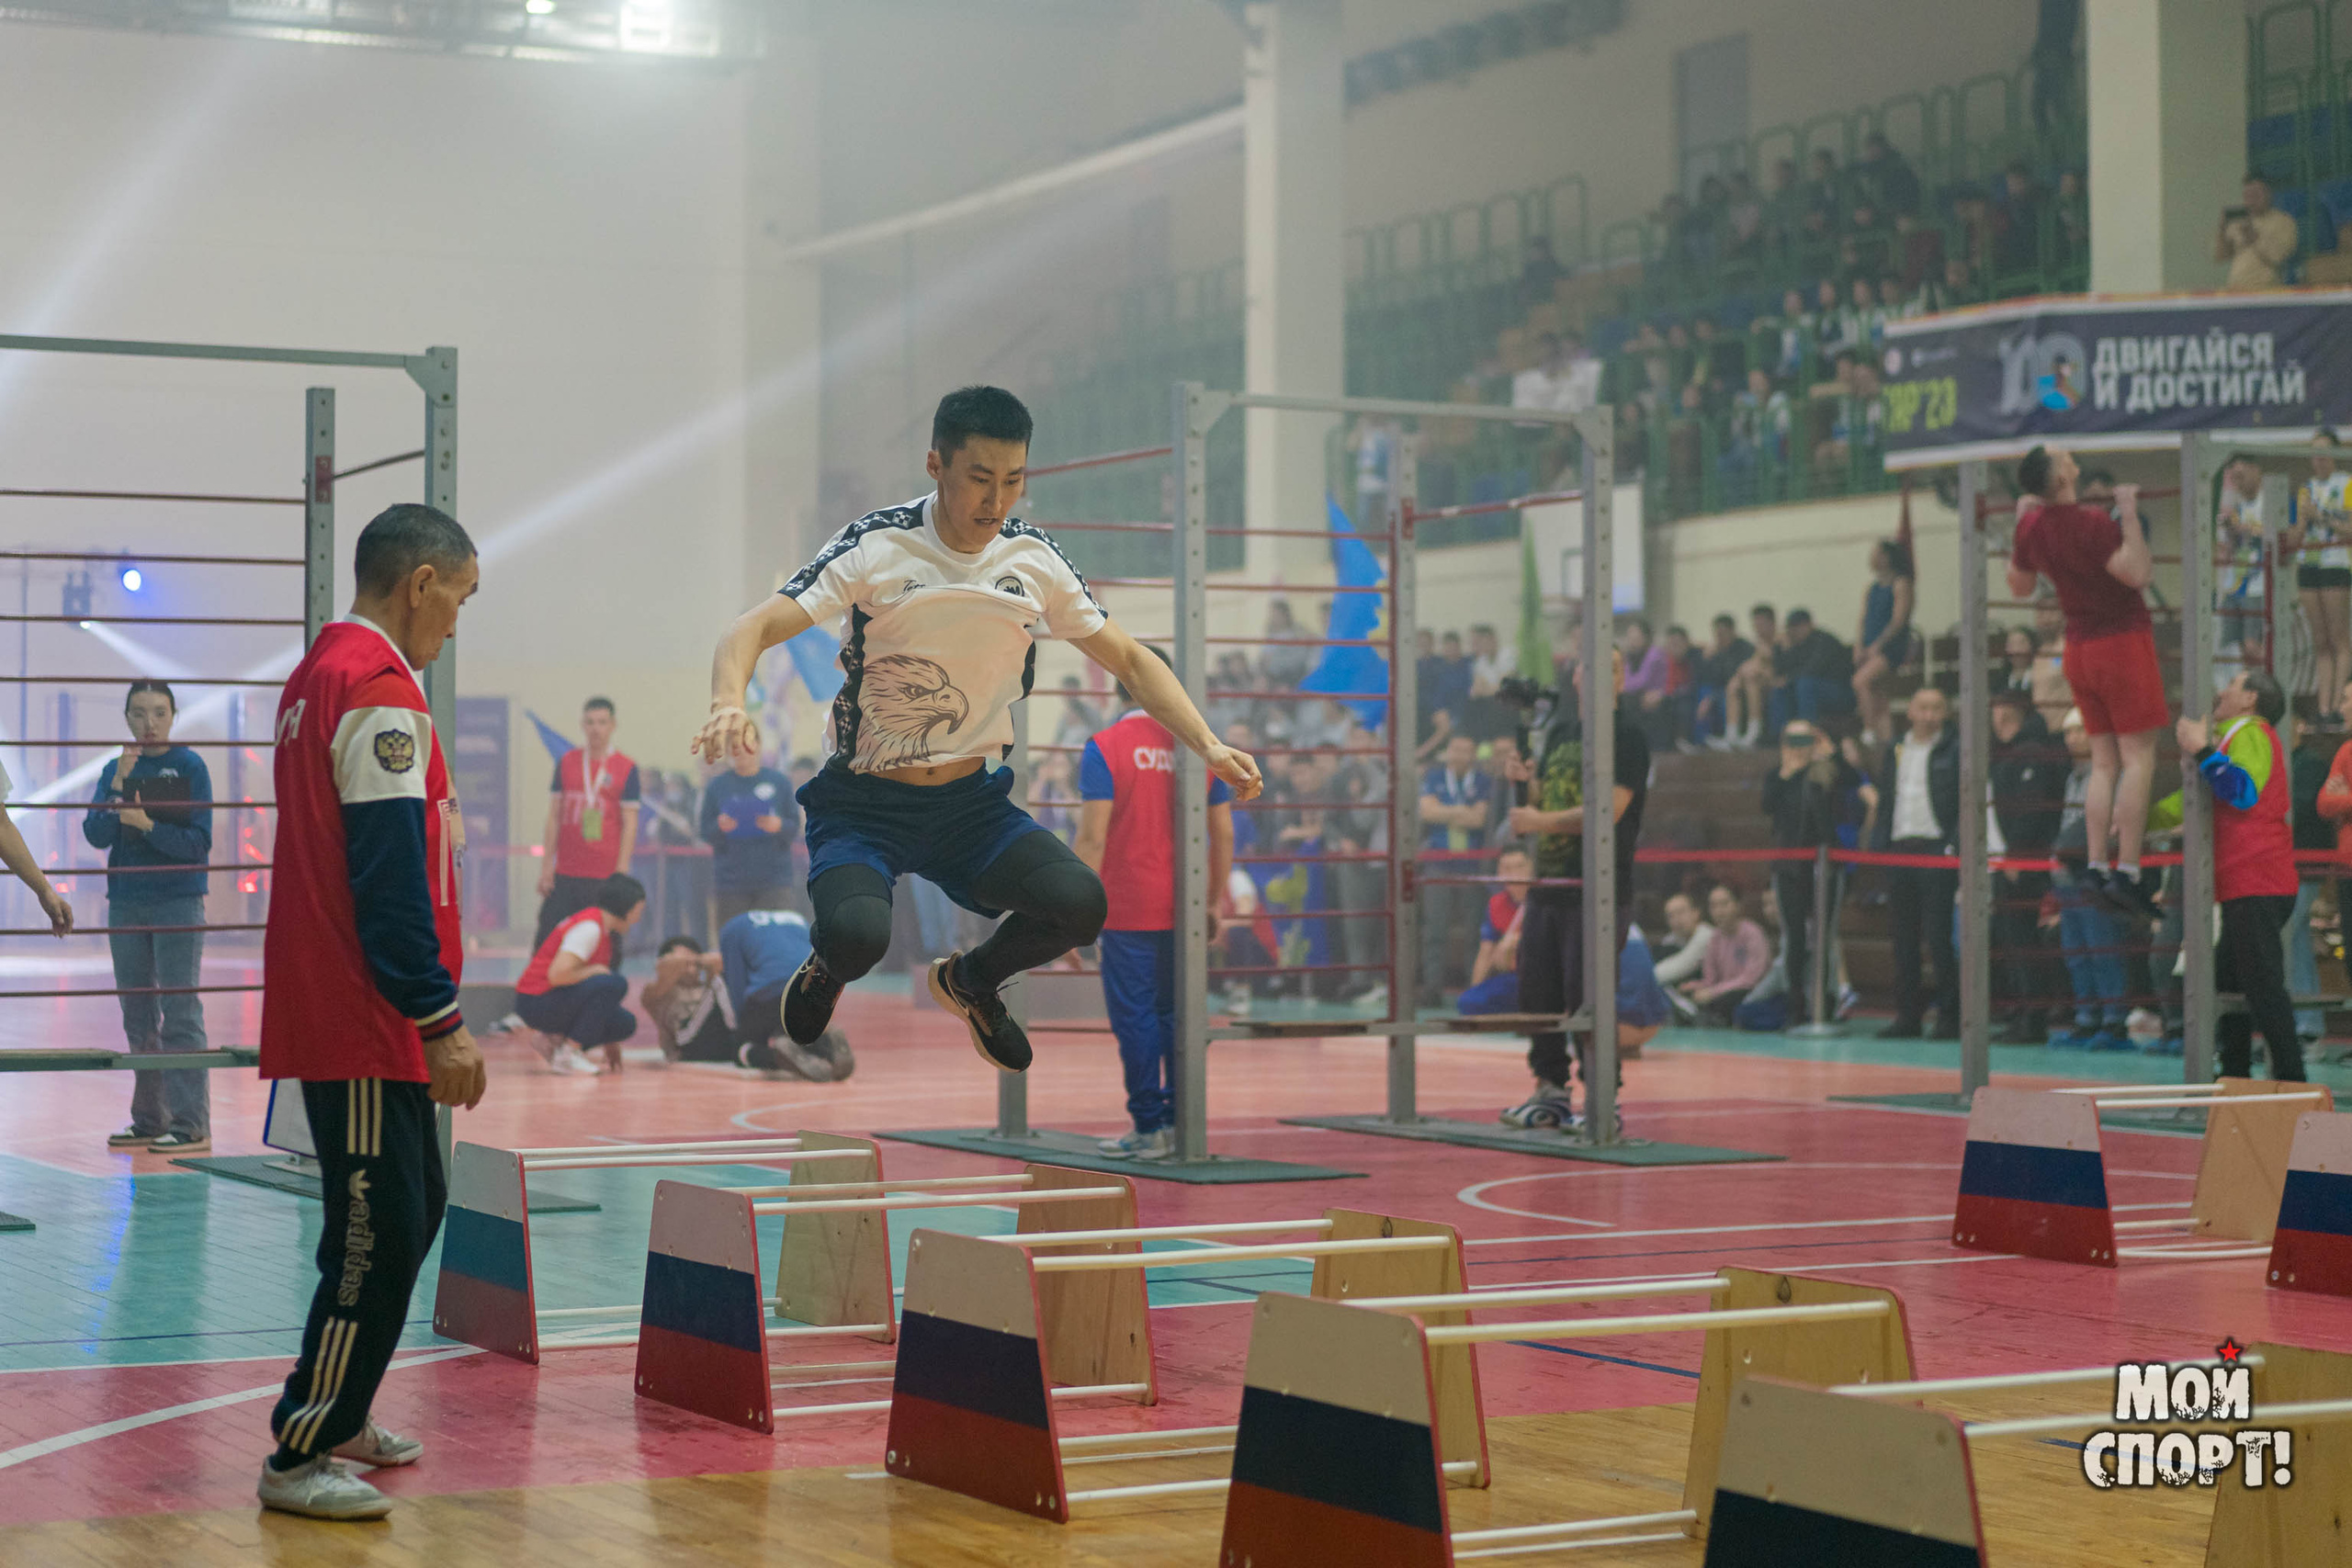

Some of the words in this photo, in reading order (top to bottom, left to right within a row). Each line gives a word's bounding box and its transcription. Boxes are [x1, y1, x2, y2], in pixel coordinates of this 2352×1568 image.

[2094, 327, 2274, 374] ДВИГАЙСЯ
[2096, 367, 2119, 410] И
[2126, 359, 2305, 413] ДОСТИГАЙ
[338, 1200, 374, 1305] adidas
